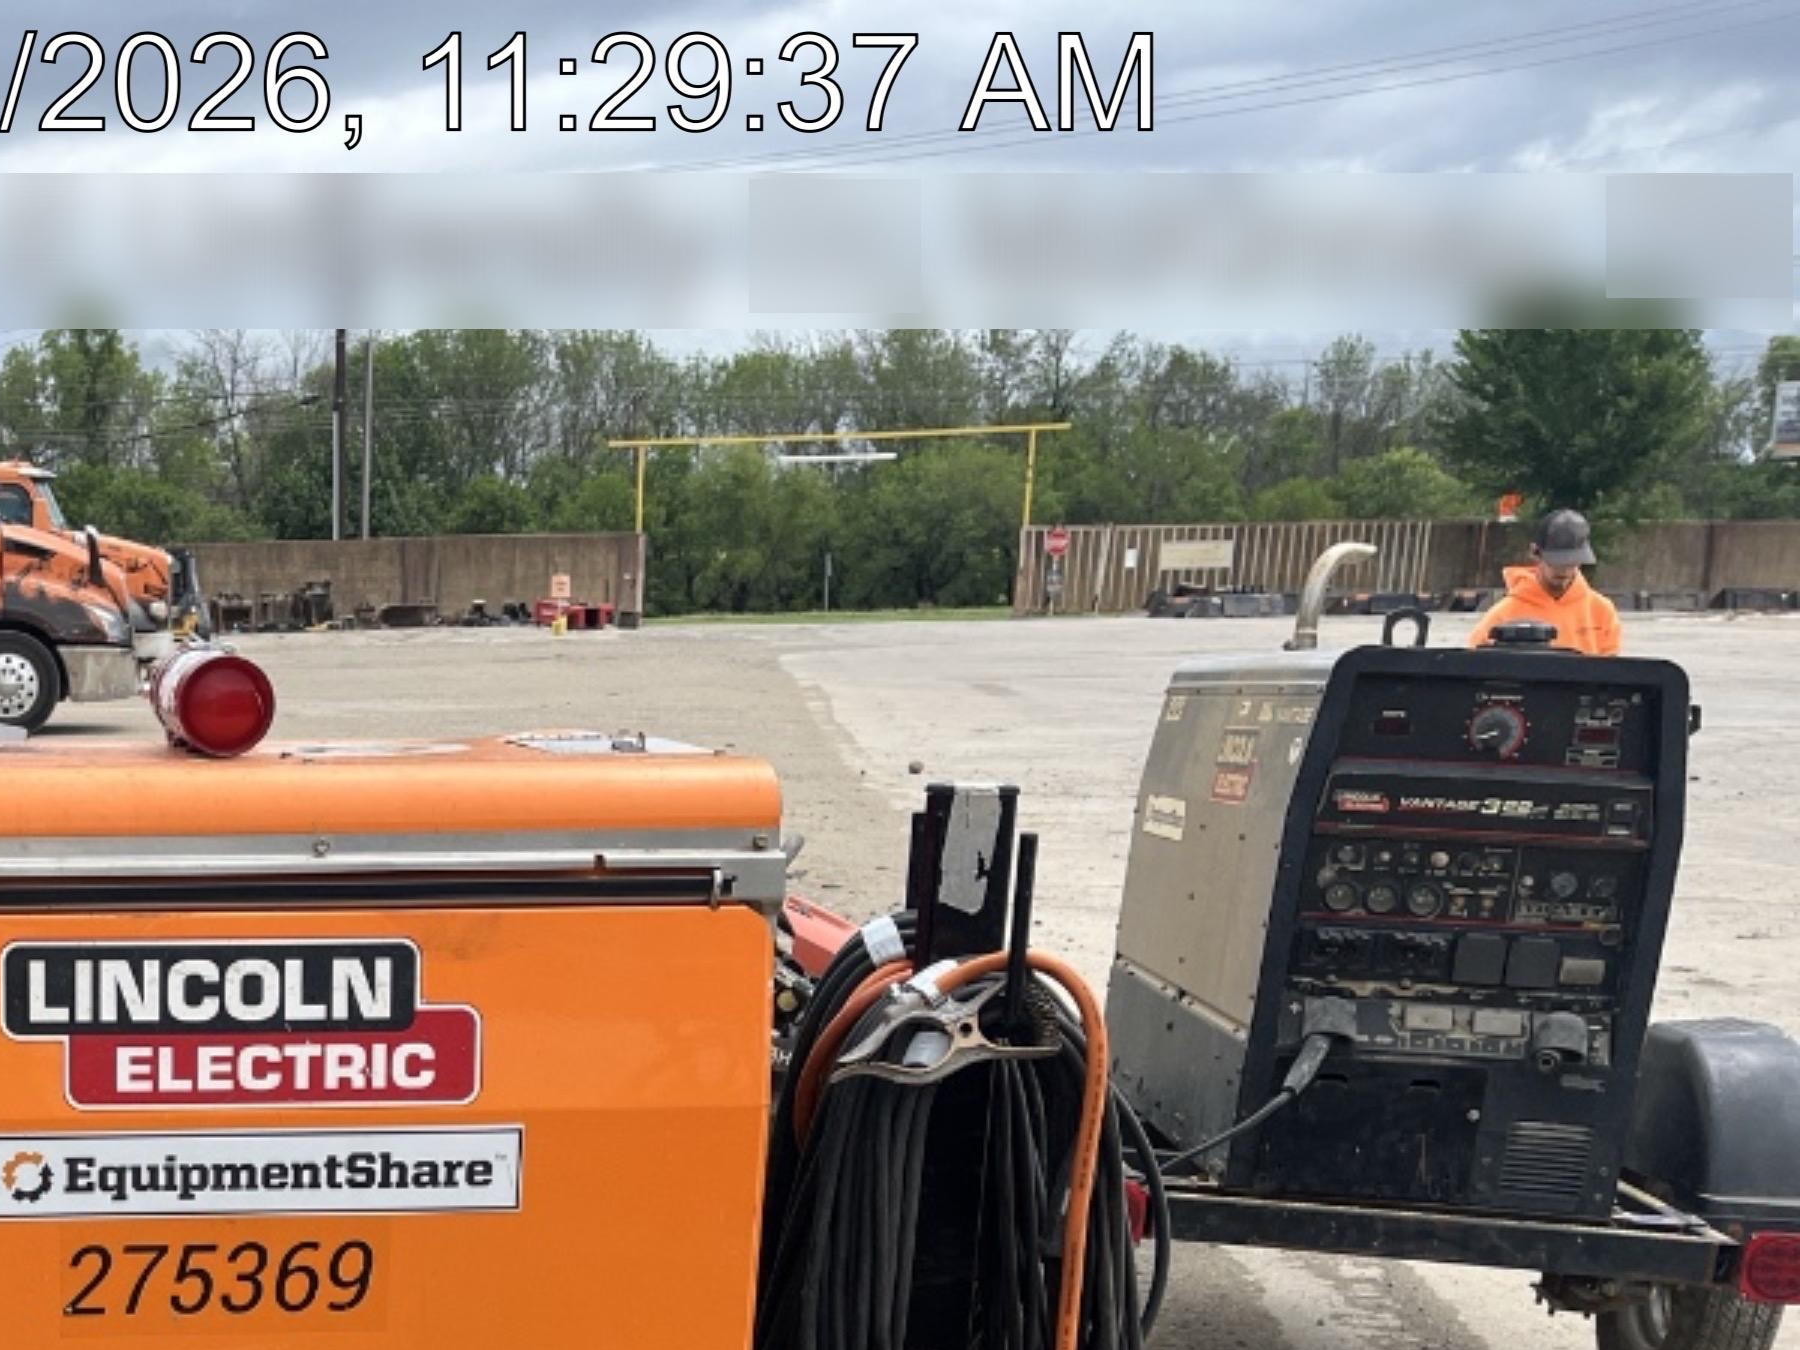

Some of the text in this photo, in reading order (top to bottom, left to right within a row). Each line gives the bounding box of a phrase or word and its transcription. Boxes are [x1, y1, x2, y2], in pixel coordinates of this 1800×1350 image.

[27, 956, 393, 1024] LINCOLN
[115, 1042, 437, 1093] ELECTRIC
[63, 1152, 494, 1200] EquipmentShare
[62, 1240, 375, 1316] 275369
